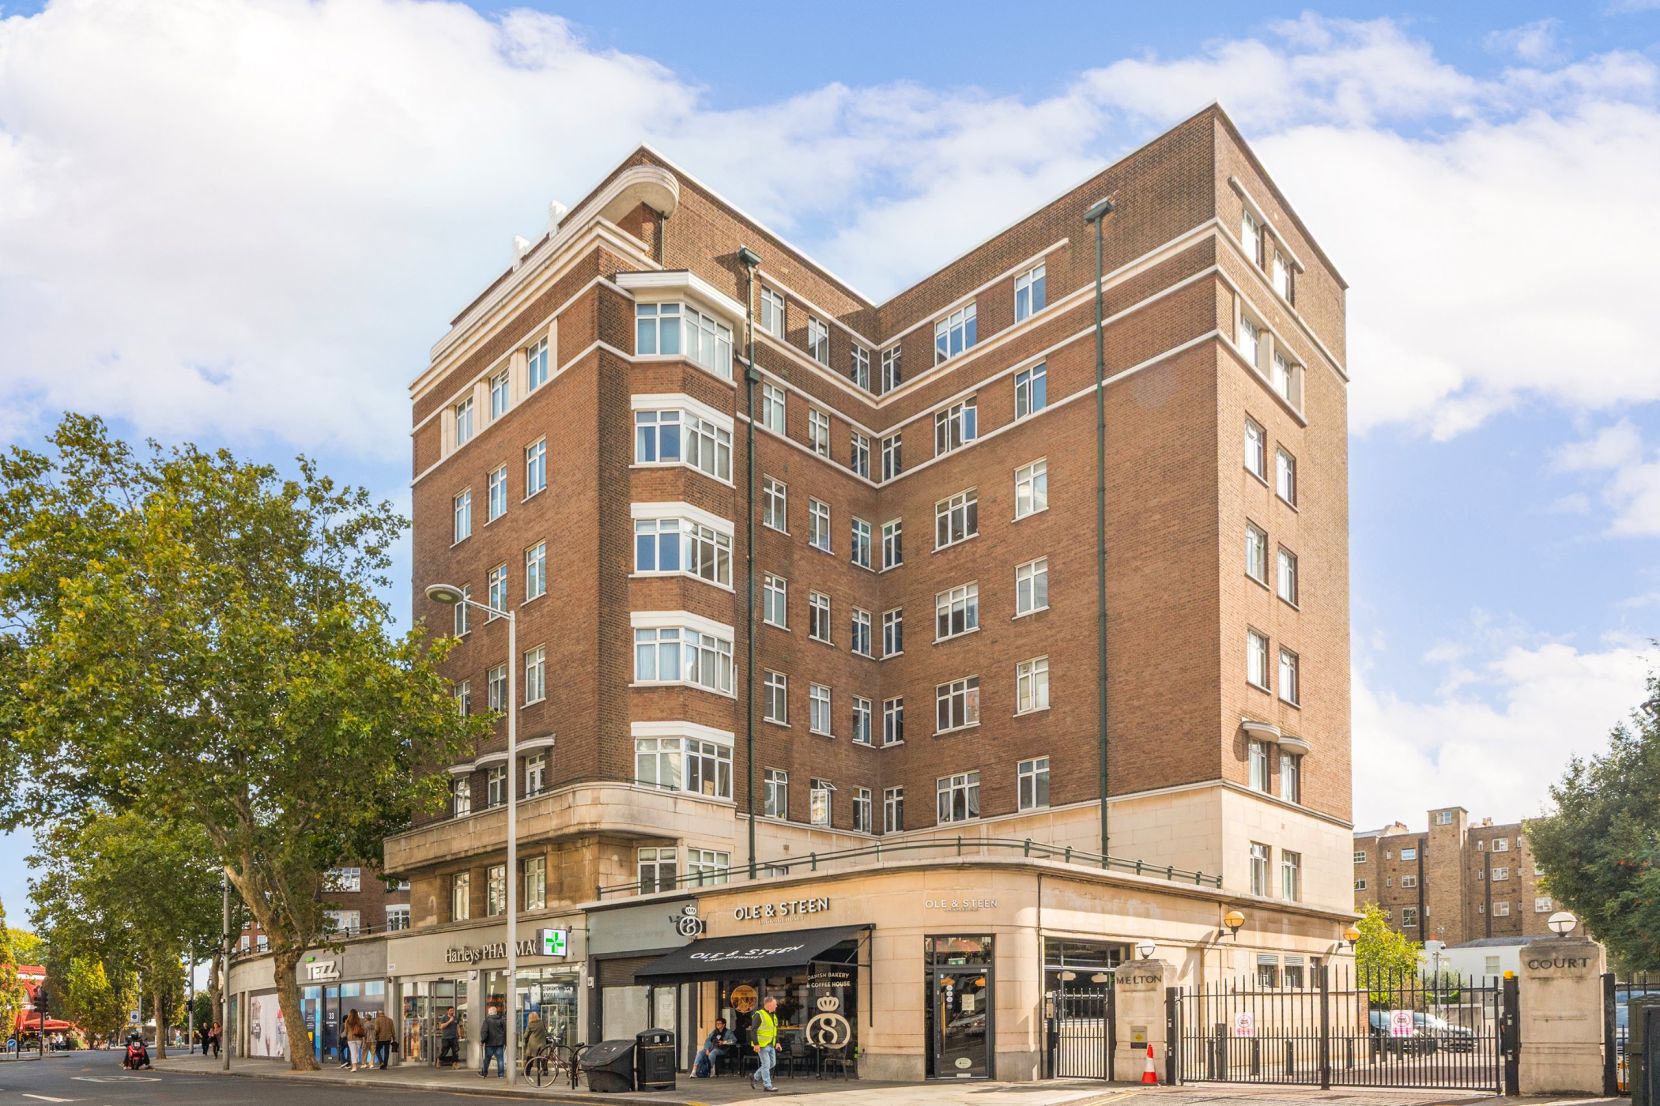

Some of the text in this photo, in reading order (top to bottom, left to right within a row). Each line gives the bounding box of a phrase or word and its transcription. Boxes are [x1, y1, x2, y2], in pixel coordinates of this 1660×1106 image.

[734, 905, 761, 920] OLE
[765, 903, 776, 917] &
[780, 897, 830, 916] STEEN
[925, 899, 998, 908] OLE & STEEN
[445, 945, 480, 965] Harleys
[744, 944, 805, 956] STEEN
[1528, 957, 1591, 970] COURT
[305, 960, 340, 980] TEZZ
[807, 972, 827, 980] DANISH
[1116, 974, 1162, 985] MELTON
